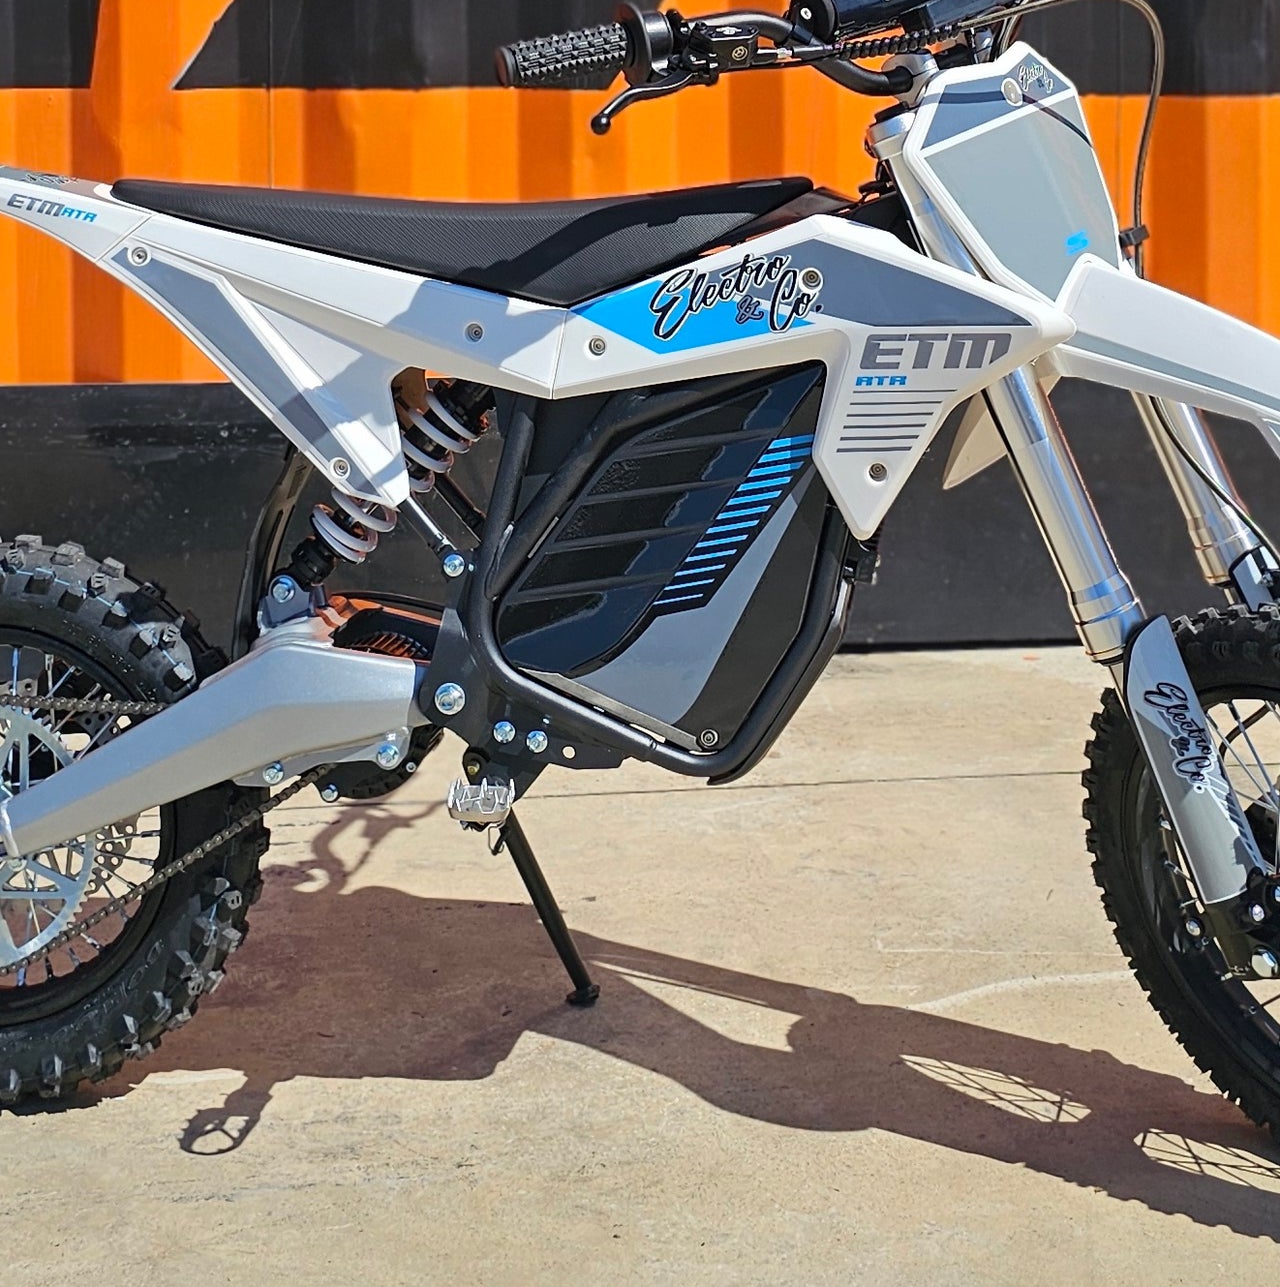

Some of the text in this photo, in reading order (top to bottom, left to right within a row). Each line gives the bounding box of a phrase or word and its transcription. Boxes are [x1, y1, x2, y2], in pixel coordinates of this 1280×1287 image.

[7, 193, 65, 217] ETM
[650, 253, 789, 340] Electro
[735, 295, 764, 324] &
[860, 333, 1013, 370] ETM
[1144, 682, 1213, 756] Electro
